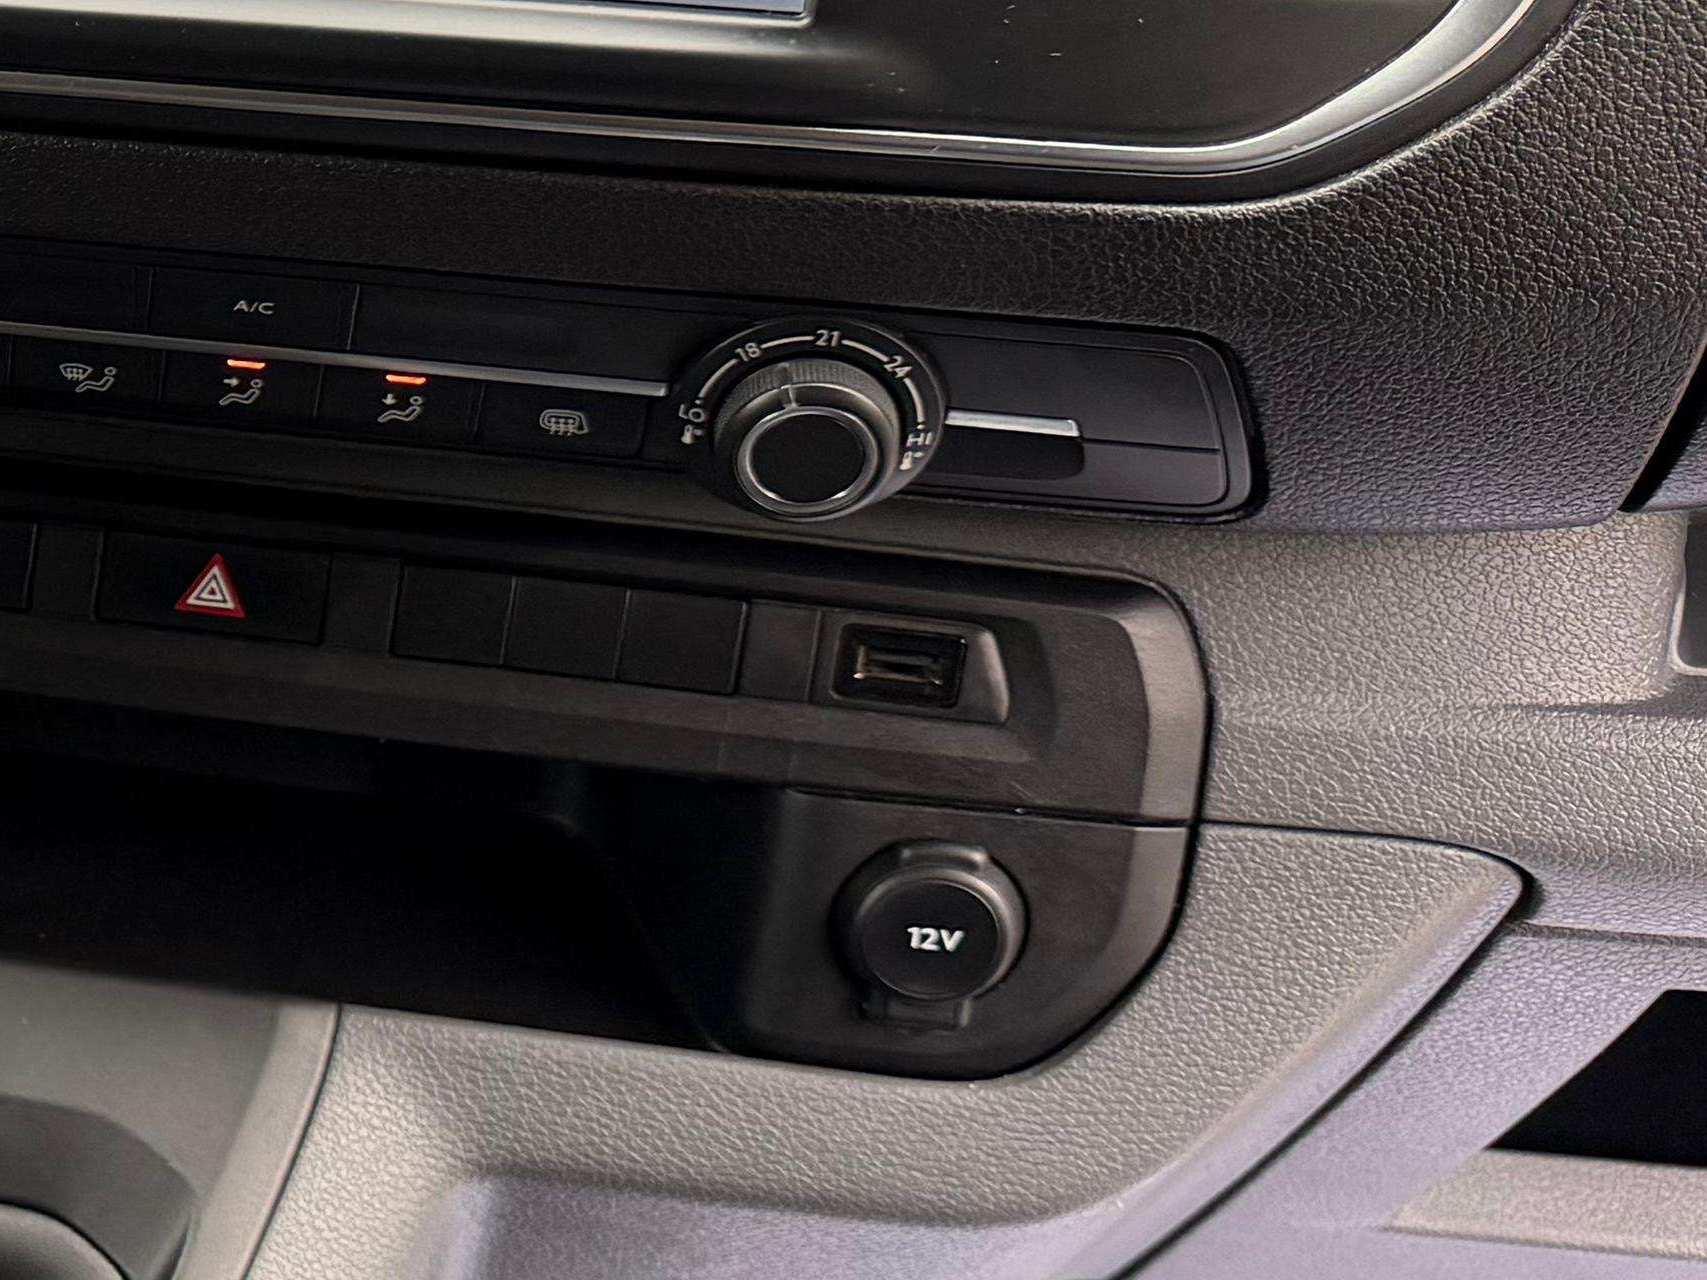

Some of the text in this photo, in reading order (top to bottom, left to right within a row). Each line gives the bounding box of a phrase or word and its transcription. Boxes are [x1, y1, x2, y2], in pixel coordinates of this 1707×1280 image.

[233, 300, 275, 315] A/C
[815, 329, 842, 348] 21
[734, 342, 762, 362] 18
[883, 355, 912, 380] 24
[906, 432, 935, 447] HI
[907, 926, 966, 952] 12V
